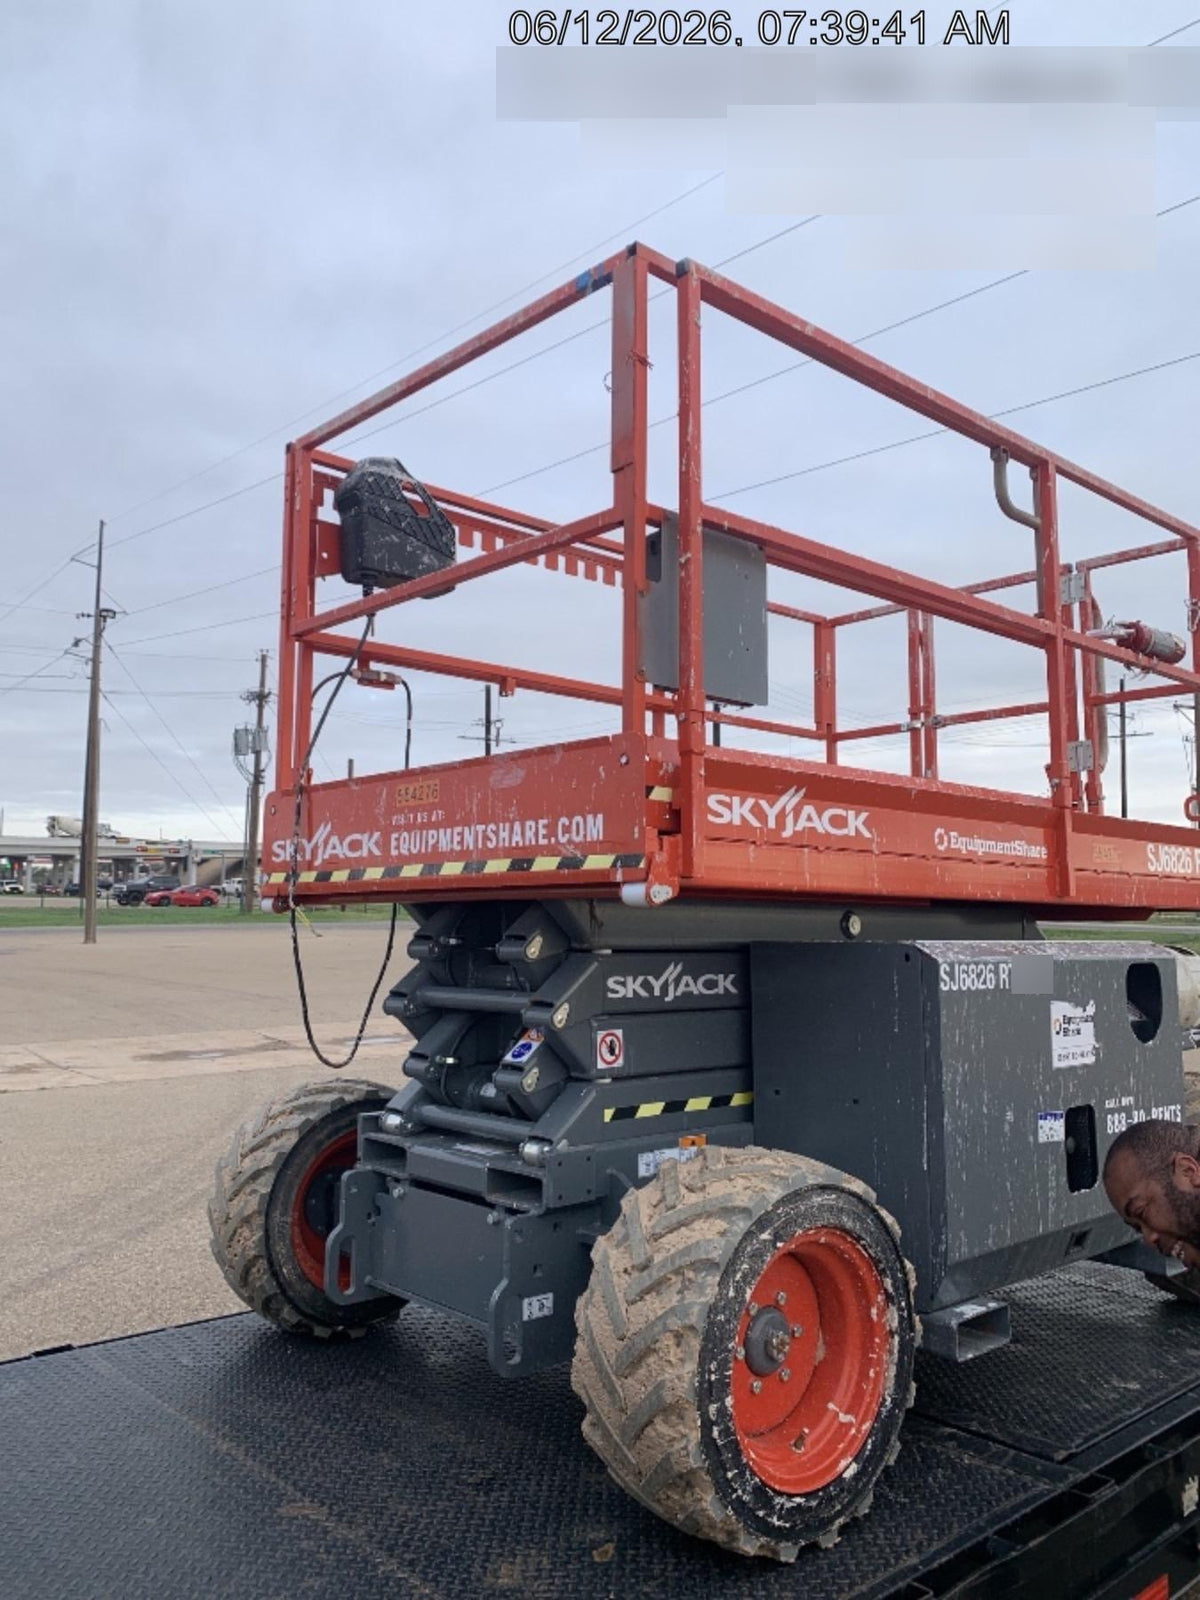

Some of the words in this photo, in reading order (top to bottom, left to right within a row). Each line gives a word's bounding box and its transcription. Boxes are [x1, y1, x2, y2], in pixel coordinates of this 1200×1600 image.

[707, 785, 872, 838] SKYJACK
[271, 821, 382, 866] SKYJACK
[390, 813, 604, 857] EQUIPMENTSHARE.COM
[949, 831, 1048, 859] EquipmentShare
[1147, 843, 1192, 873] SJ6826
[606, 962, 739, 1002] SKYJACK
[940, 963, 995, 991] SJ6826
